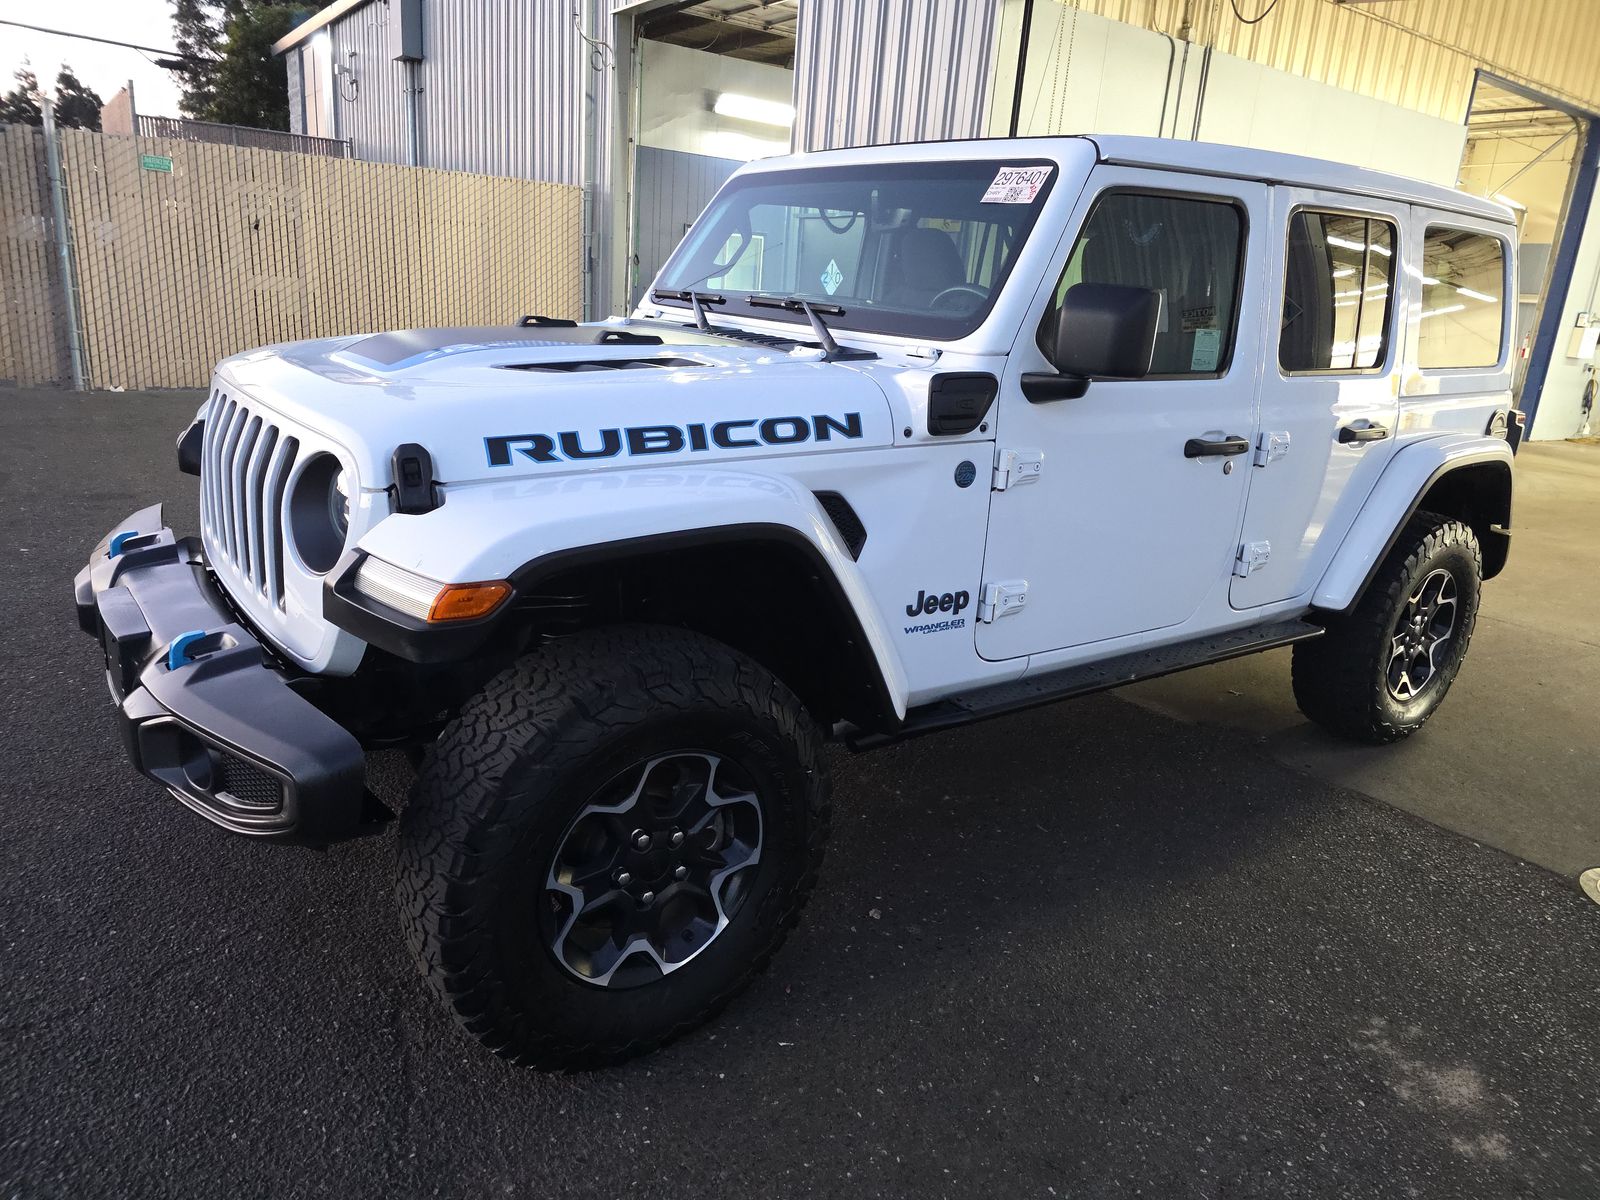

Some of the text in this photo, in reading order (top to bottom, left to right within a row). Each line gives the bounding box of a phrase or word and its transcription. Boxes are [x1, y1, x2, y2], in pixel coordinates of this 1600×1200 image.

[994, 171, 1049, 186] 2976401
[483, 412, 863, 467] RUBICON
[906, 590, 970, 617] Jeep
[904, 618, 965, 634] WRANGLER
[922, 624, 966, 635] UNLIMITED
